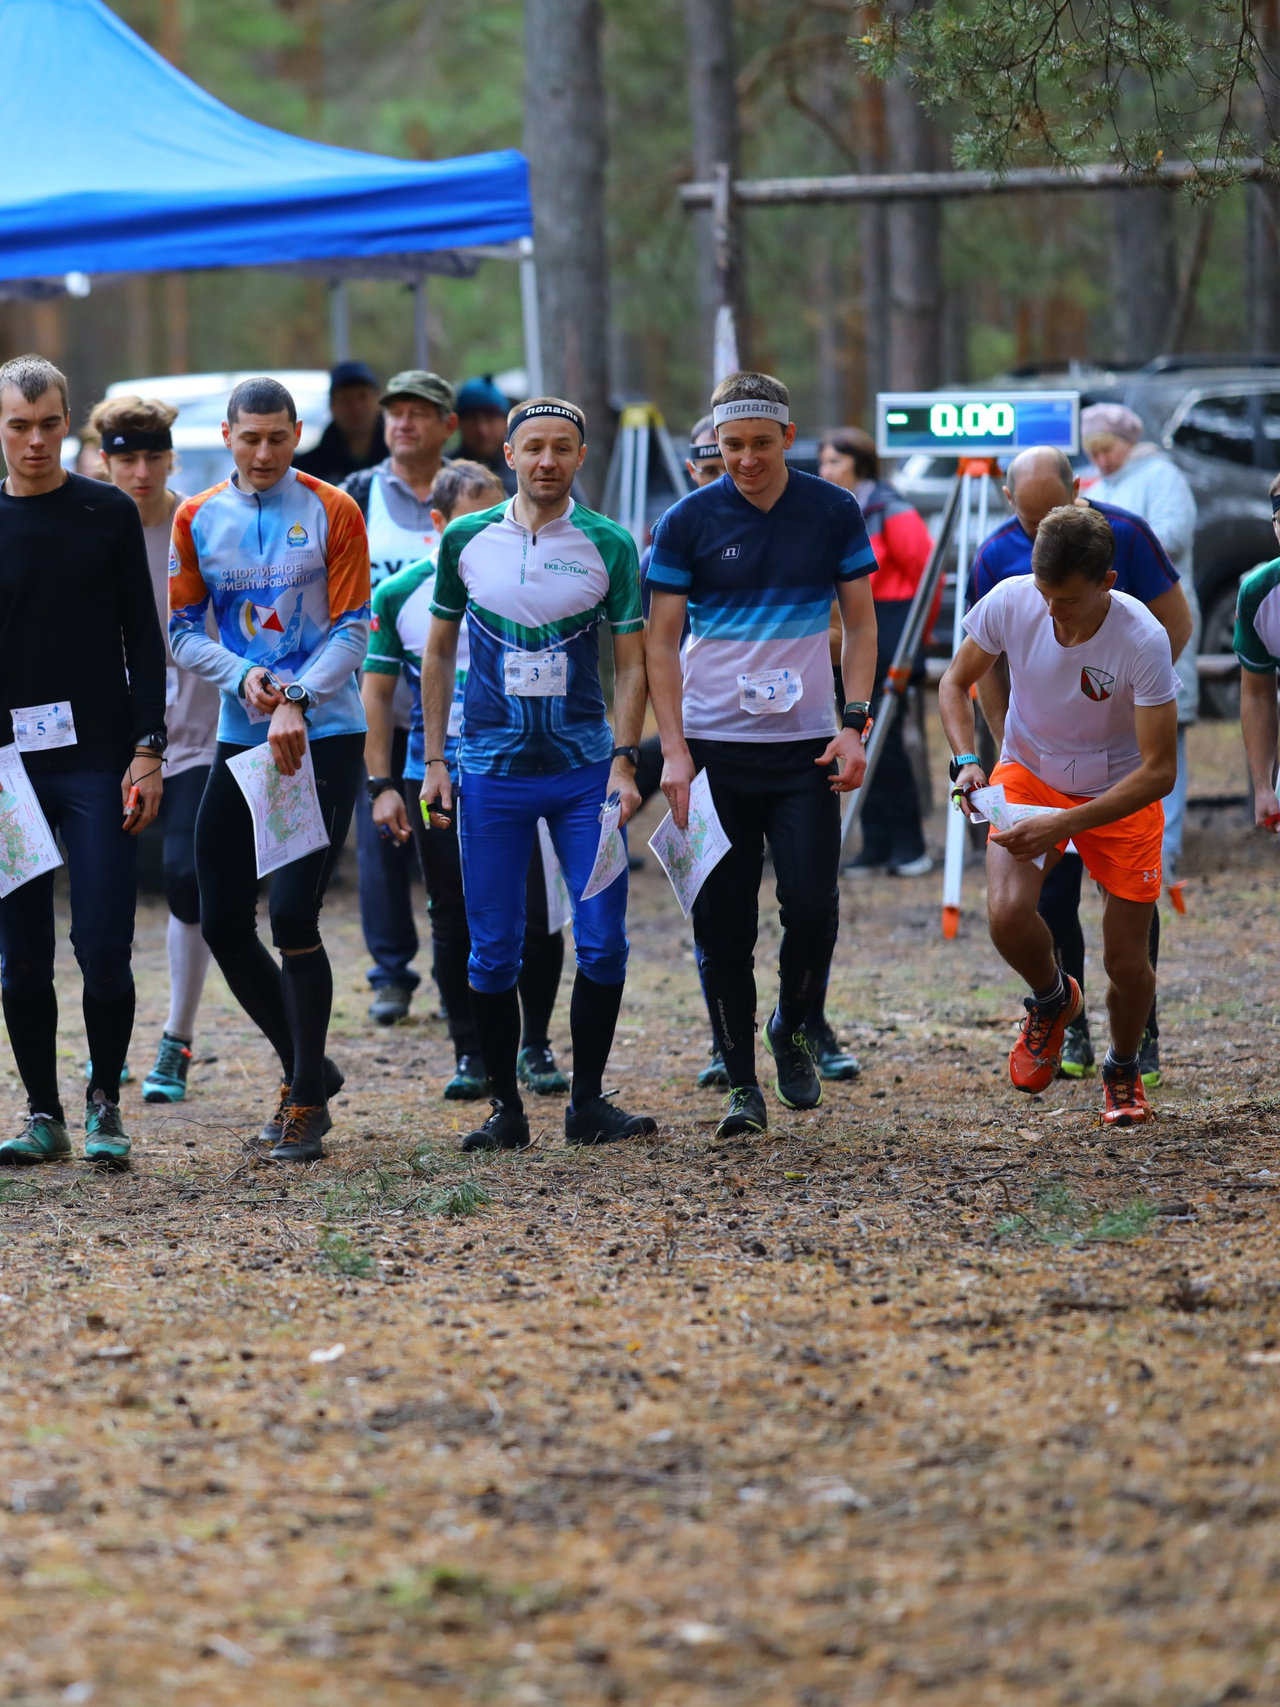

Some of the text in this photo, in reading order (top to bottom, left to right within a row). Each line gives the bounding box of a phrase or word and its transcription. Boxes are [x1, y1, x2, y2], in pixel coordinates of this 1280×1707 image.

[525, 405, 578, 422] noname
[725, 403, 779, 415] noname
[930, 403, 1014, 436] 0.00
[221, 564, 304, 580] СПОРТИВНОЕ
[216, 574, 314, 592] ОРИЕНТИРОВАНИЕ
[531, 667, 540, 681] 3
[767, 686, 776, 700] 2
[37, 721, 46, 736] 5
[1063, 759, 1075, 785] 1
